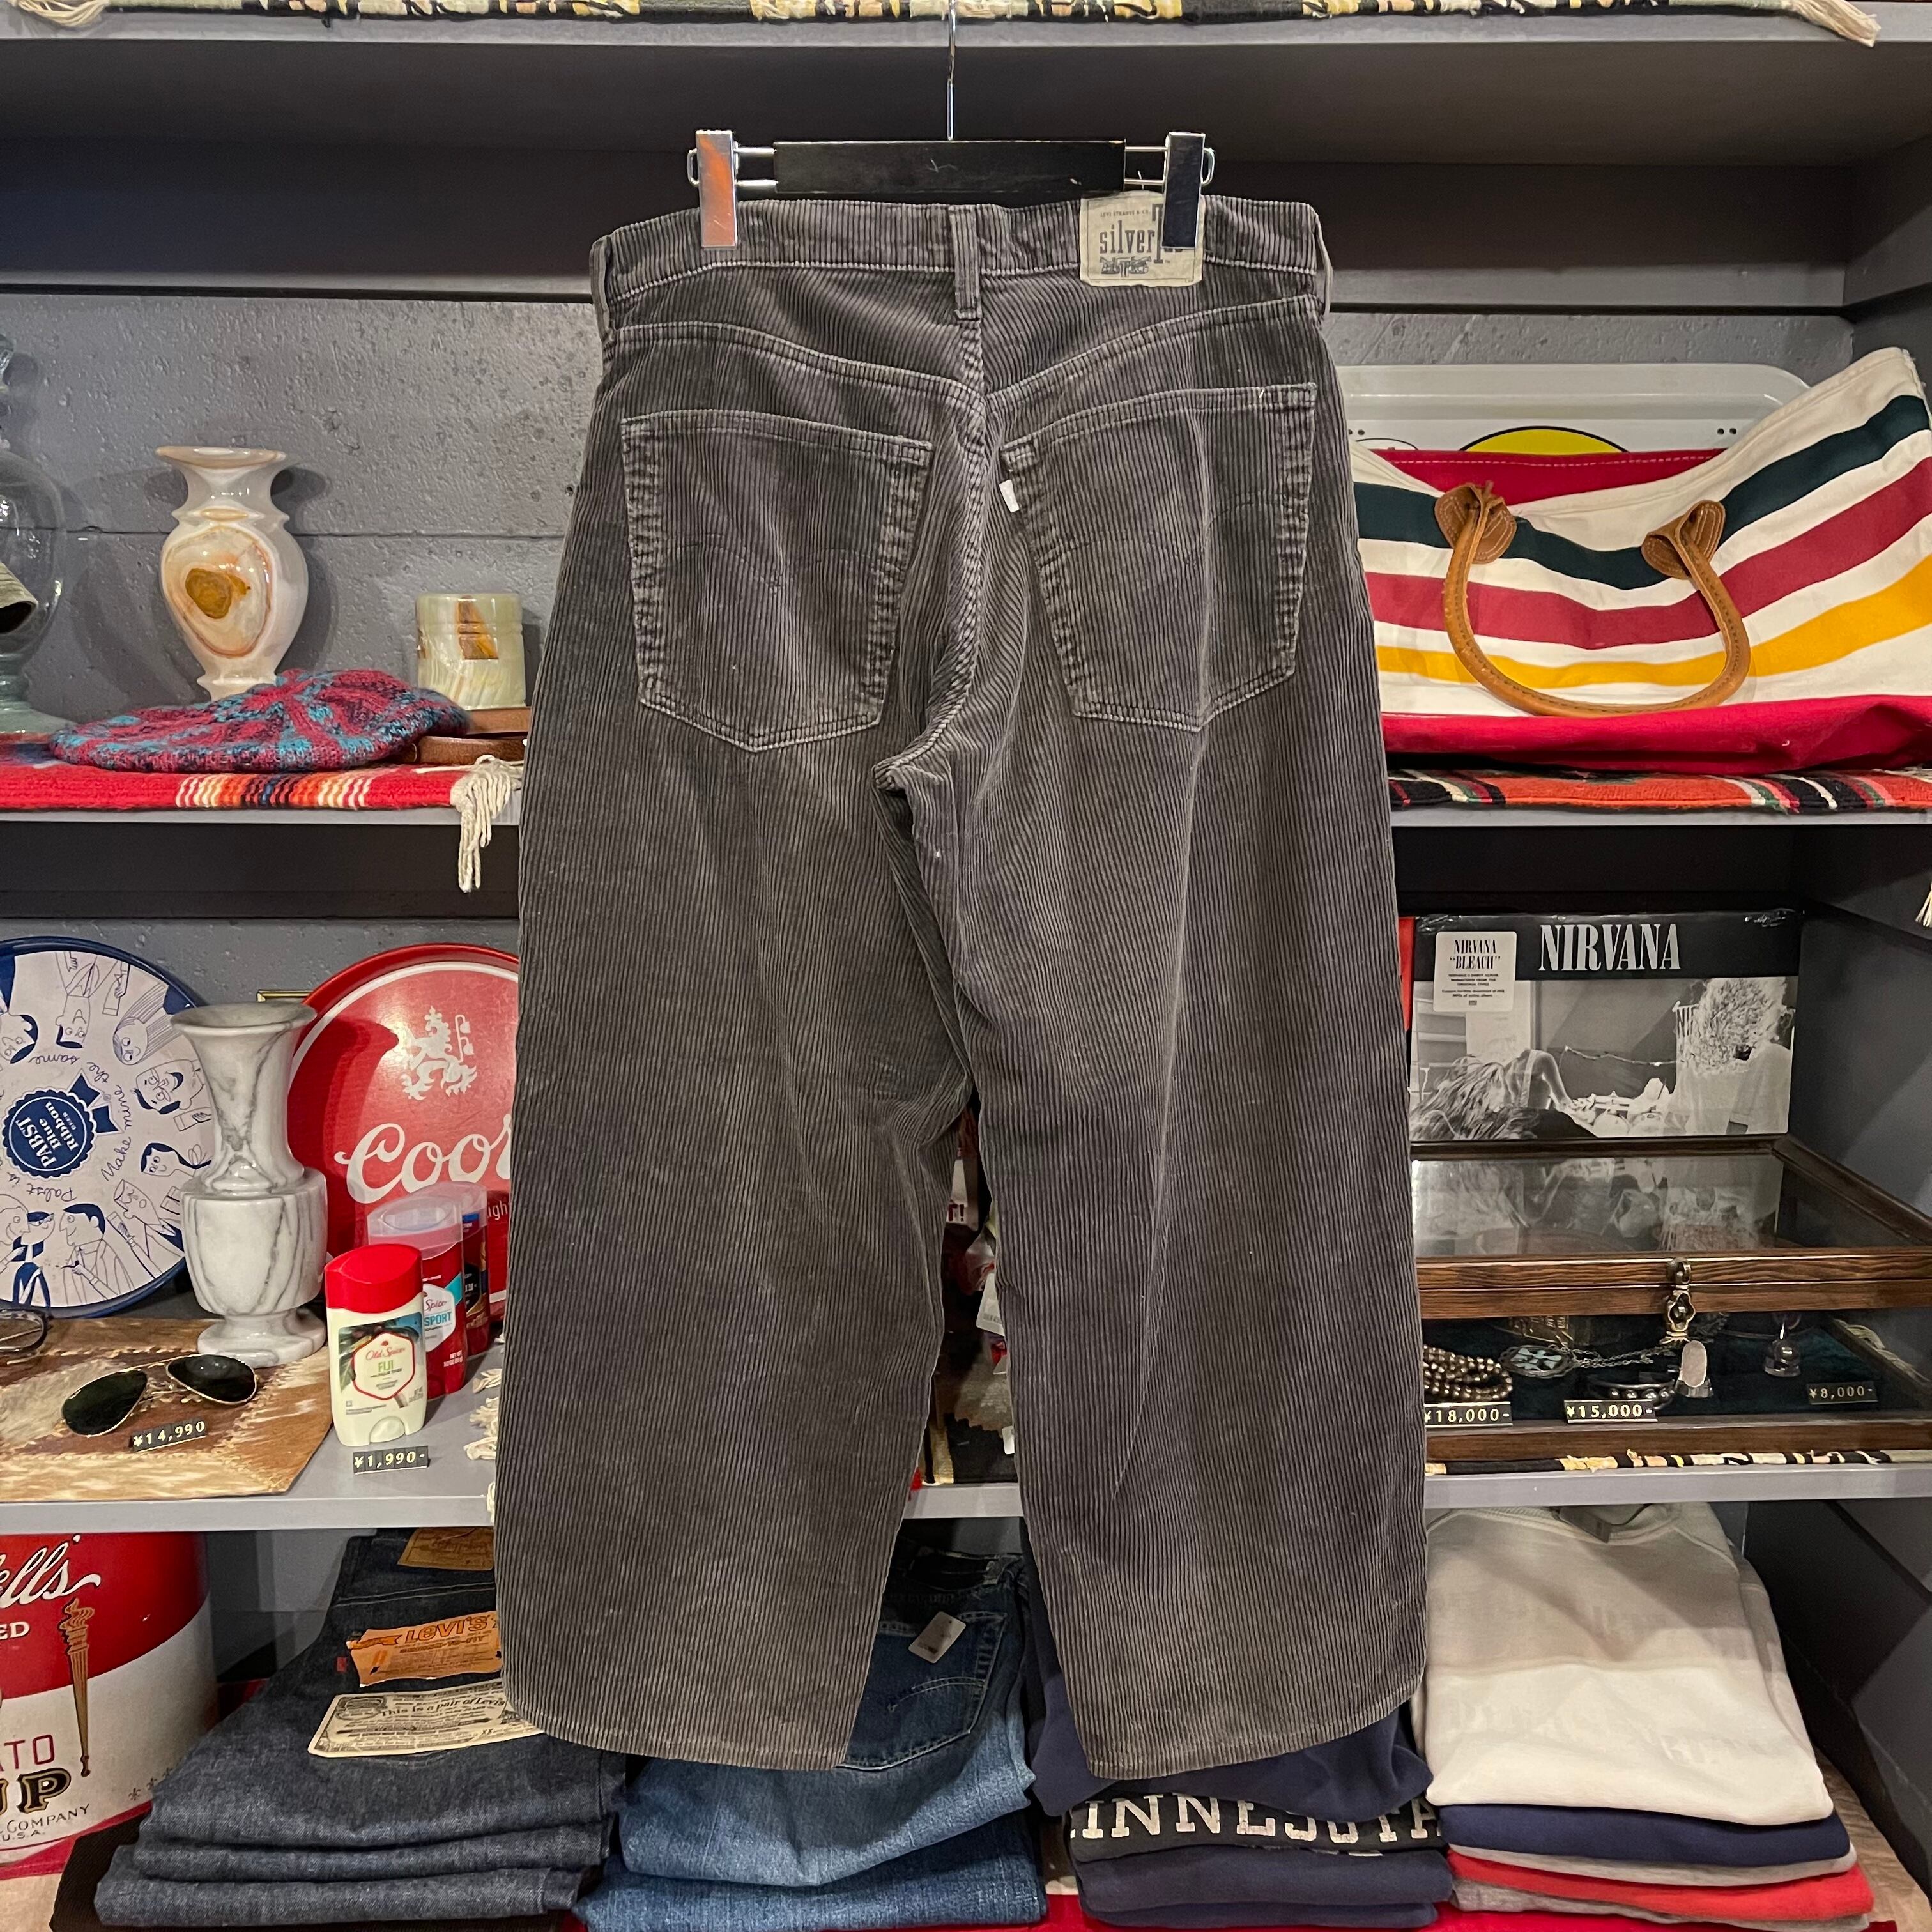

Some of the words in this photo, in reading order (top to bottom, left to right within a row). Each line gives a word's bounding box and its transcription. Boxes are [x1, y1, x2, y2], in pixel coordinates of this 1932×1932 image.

[1099, 203, 1183, 264] silverT
[1453, 939, 1496, 954] NIRVANA
[1538, 923, 1681, 971] NIRVANA
[28, 1054, 81, 1066] same
[87, 1061, 109, 1084] the
[114, 1085, 133, 1129] mine
[39, 1118, 62, 1151] Blue
[45, 1101, 79, 1151] Ribbon
[15, 1116, 57, 1169] PABST
[101, 1136, 132, 1182] Make
[26, 1183, 77, 1202] Pabst
[486, 1200, 511, 1221] igh
[424, 1312, 452, 1327] SPORT
[1809, 1386, 1873, 1400] ¥8,000-
[1567, 1404, 1654, 1420] ¥15,000-
[133, 1420, 205, 1448] ¥14,990
[353, 1451, 425, 1469] ¥1,990-
[382, 1708, 408, 1717] This
[436, 1698, 461, 1713] pair
[0, 1735, 55, 1772] TO
[7, 1803, 89, 1833] COMPANY
[1070, 1791, 1441, 1844] INNETA
